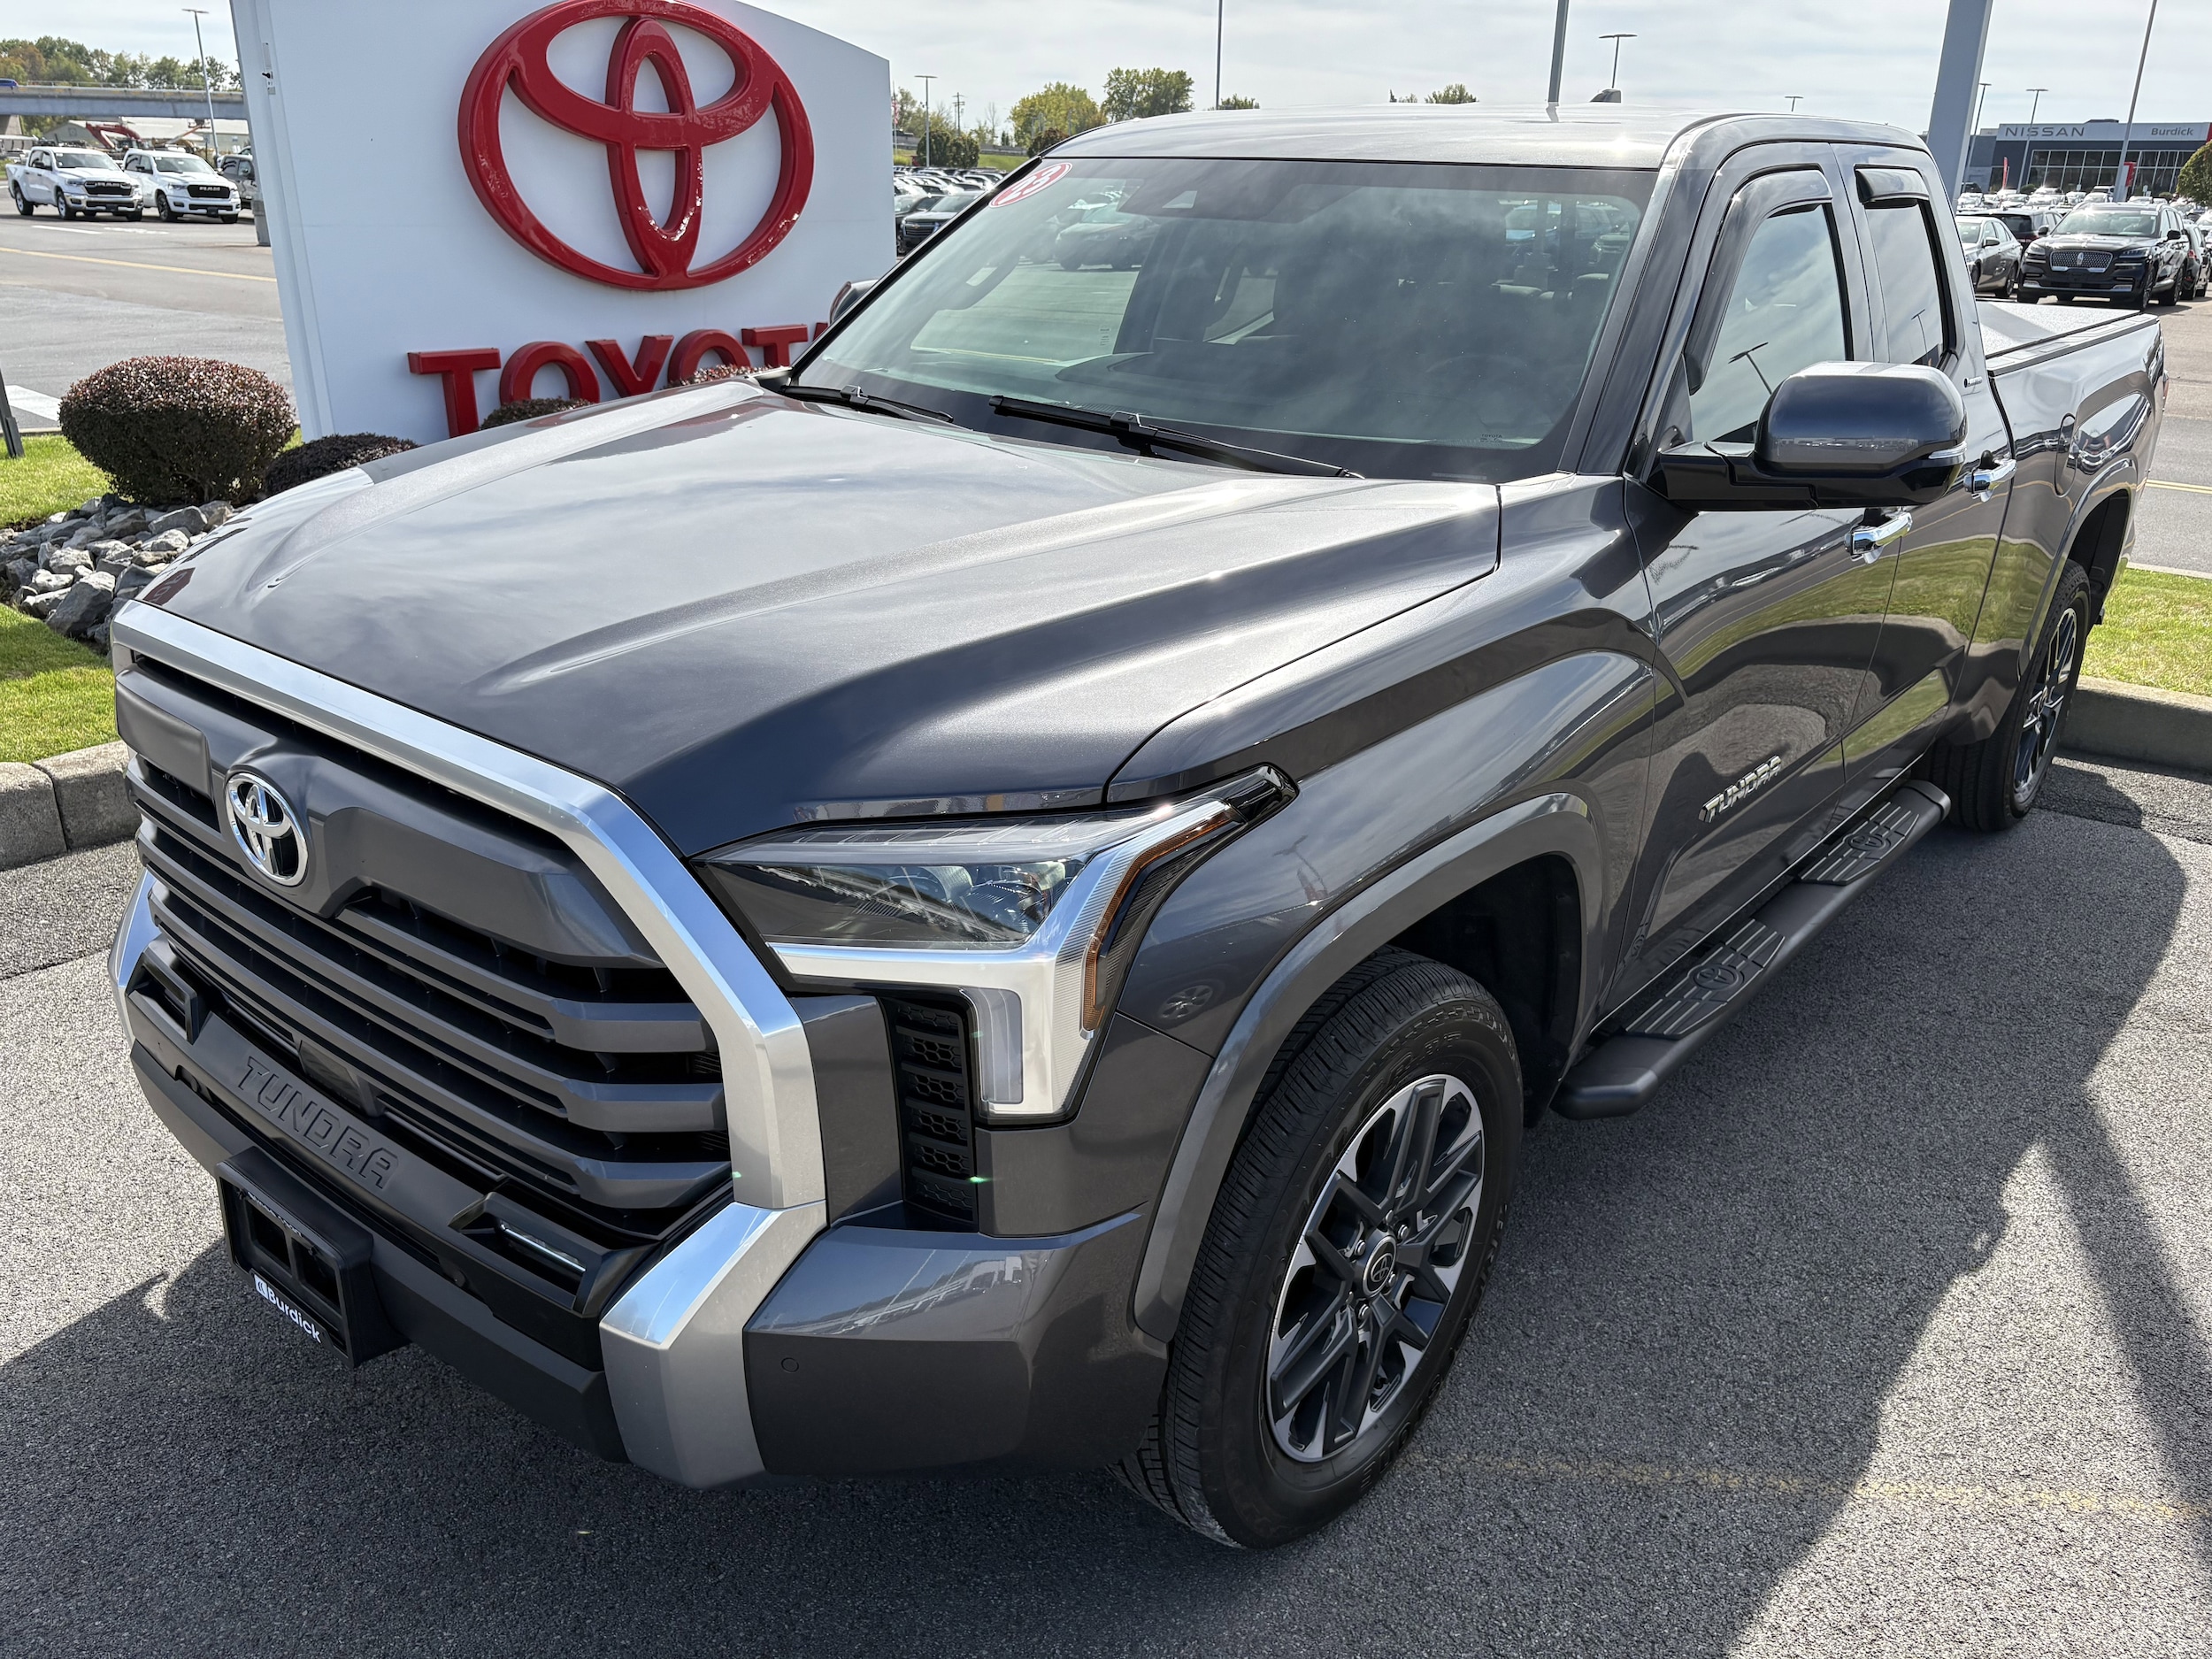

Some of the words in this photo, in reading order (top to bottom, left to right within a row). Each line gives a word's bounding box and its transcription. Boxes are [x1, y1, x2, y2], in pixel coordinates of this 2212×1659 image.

[2005, 127, 2085, 137] NISSAN
[2151, 127, 2194, 136] Burdick
[407, 322, 829, 439] TOYOT
[1698, 755, 1782, 824] TUNDRA
[238, 1056, 400, 1190] TUNDRA
[267, 1286, 321, 1343] Burdick
